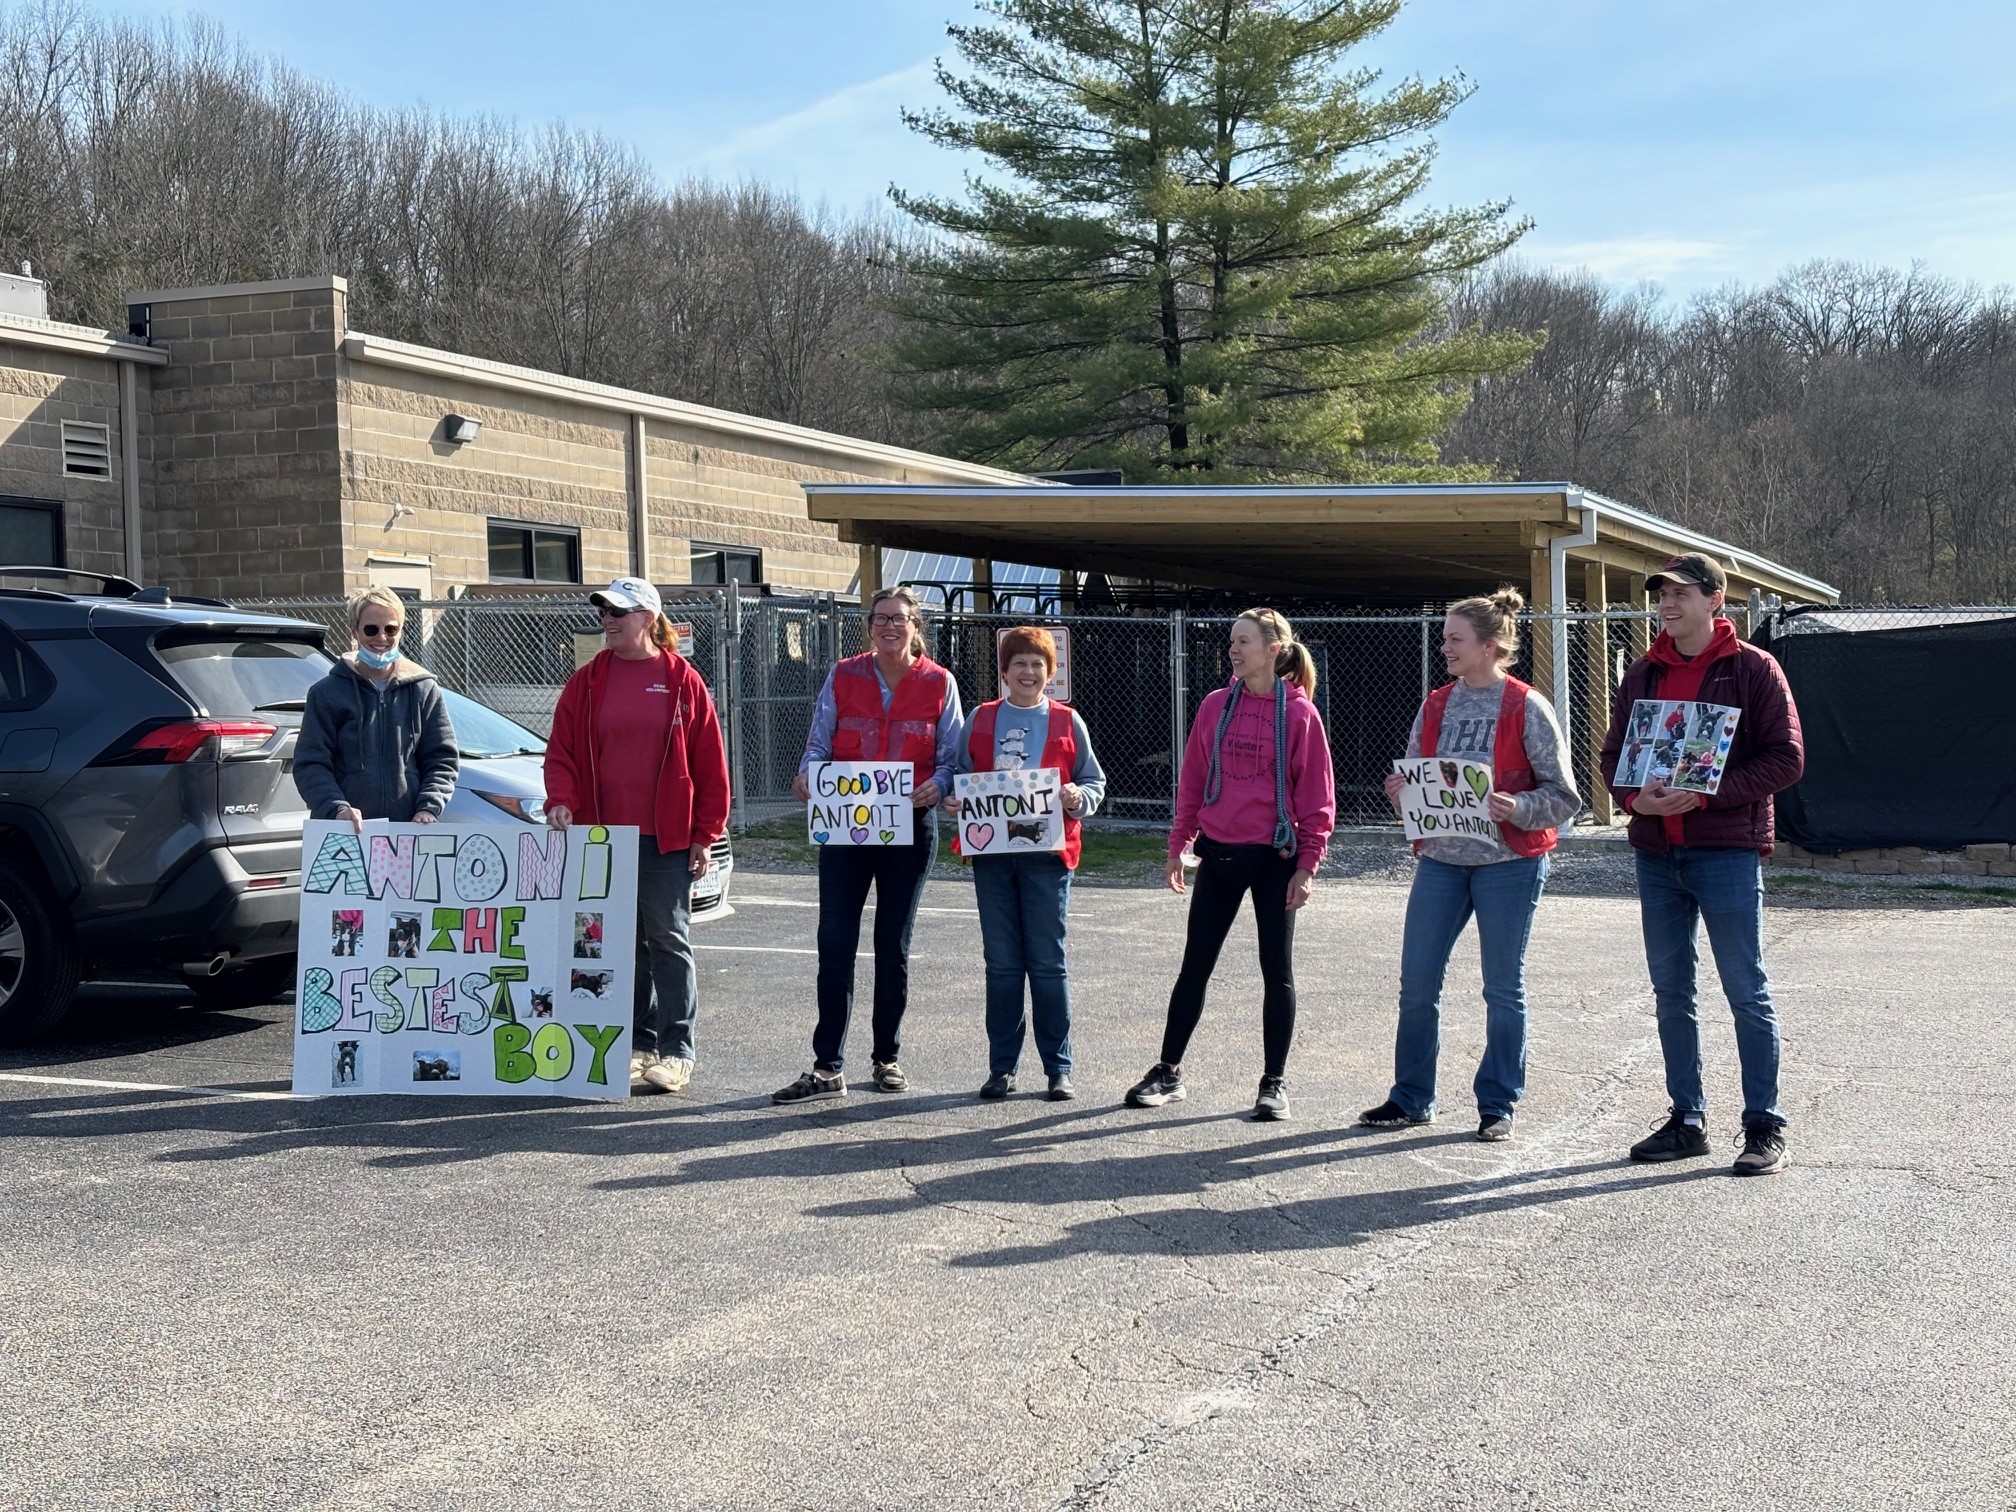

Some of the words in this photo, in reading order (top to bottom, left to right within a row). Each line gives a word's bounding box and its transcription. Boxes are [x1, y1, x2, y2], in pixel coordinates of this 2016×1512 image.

[1398, 761, 1437, 786] WE
[960, 787, 1054, 821] ANTONI
[1421, 786, 1478, 810] LOVE
[426, 905, 527, 961] THE
[301, 965, 529, 1036] BESTEST
[493, 1021, 625, 1086] BOY
